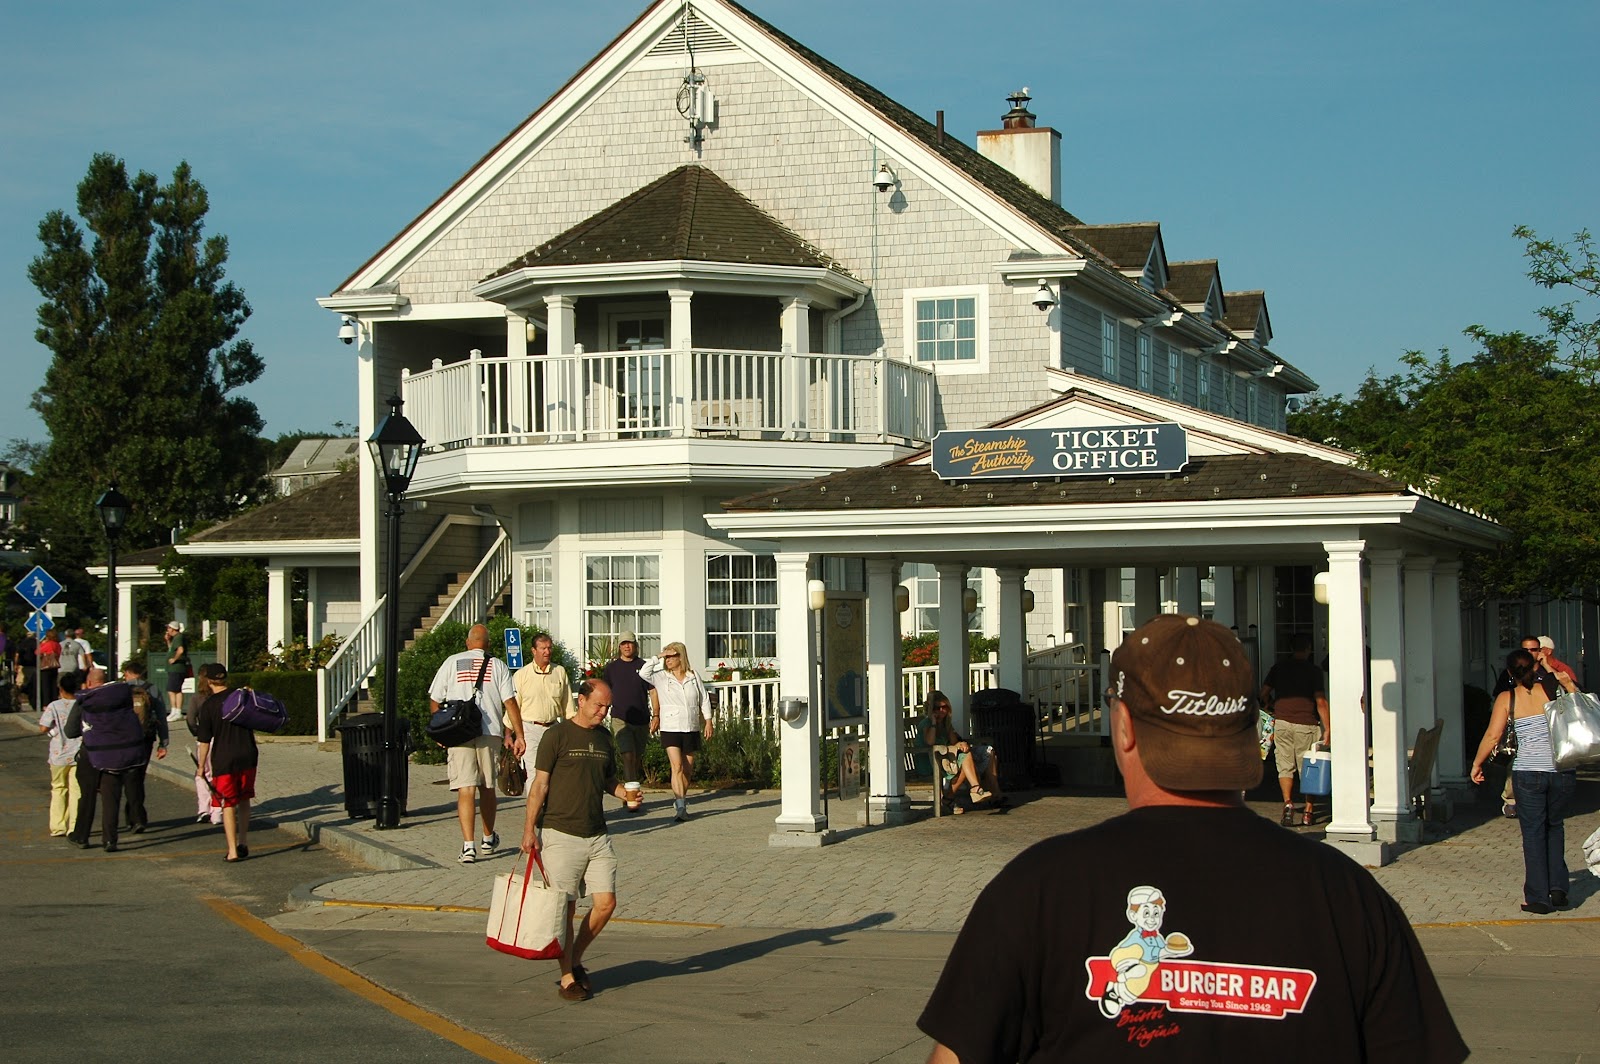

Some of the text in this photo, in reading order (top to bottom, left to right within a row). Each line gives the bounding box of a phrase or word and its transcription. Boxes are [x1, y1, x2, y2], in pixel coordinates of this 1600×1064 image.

[949, 436, 1026, 458] The Steamship
[1051, 428, 1159, 449] TICKET
[971, 453, 1035, 472] Authority
[1052, 449, 1158, 471] OFFICE
[1160, 689, 1248, 716] Titleist
[1161, 969, 1297, 1001] BURGER BAR
[1179, 997, 1271, 1012] Serving You Since 1942
[1117, 1005, 1165, 1027] Bristol
[1128, 1023, 1180, 1047] Virginia
